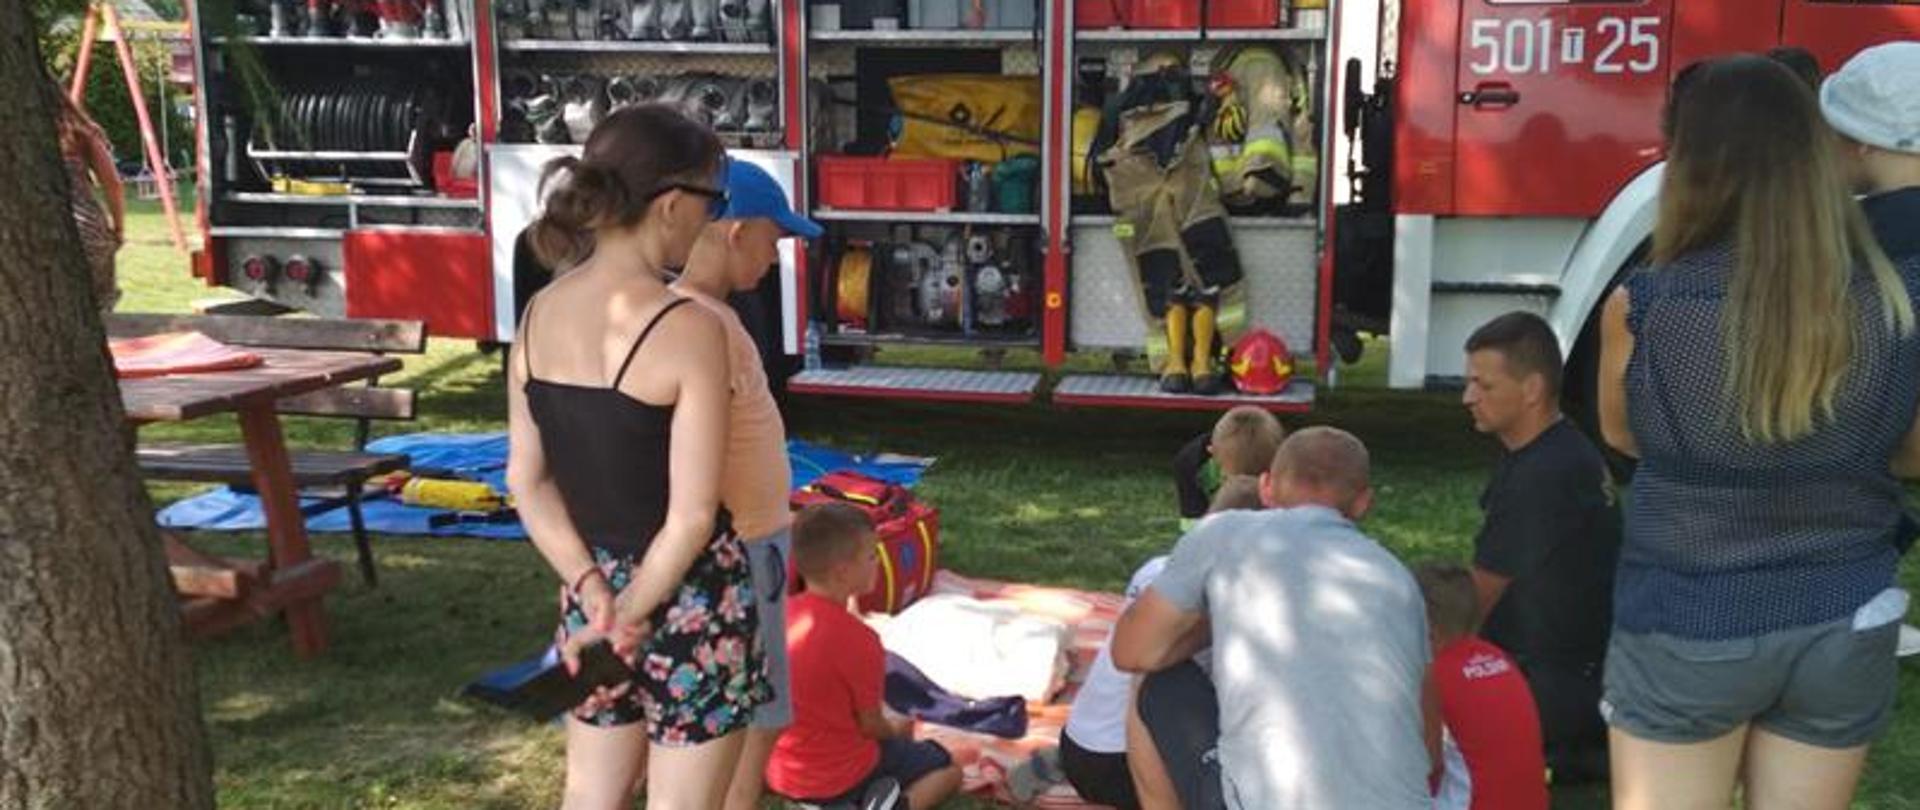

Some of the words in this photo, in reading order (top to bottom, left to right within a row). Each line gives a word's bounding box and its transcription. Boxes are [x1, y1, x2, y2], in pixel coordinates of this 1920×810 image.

[1470, 19, 1552, 73] 501
[1564, 30, 1582, 60] T
[1594, 17, 1660, 73] 25
